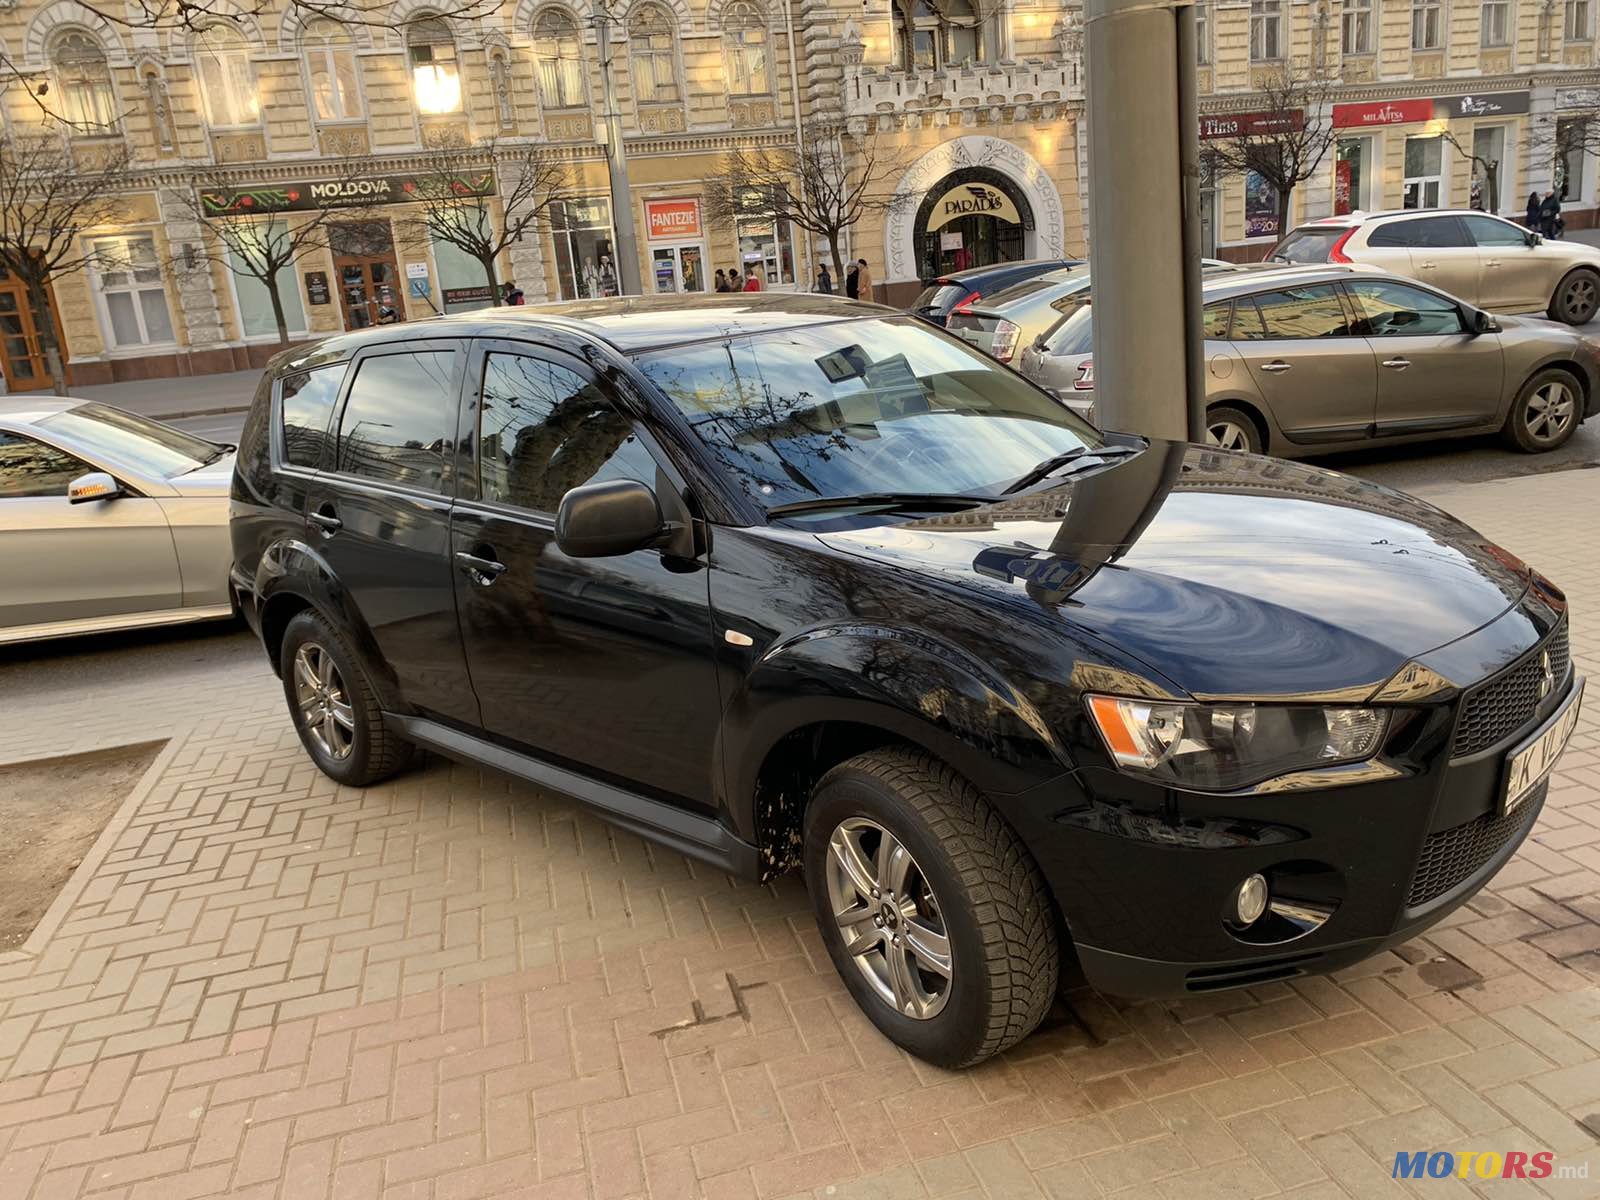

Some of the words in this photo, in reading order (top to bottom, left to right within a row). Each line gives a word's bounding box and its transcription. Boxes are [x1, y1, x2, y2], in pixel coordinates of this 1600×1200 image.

[310, 180, 391, 198] MOLDOVA
[945, 196, 1003, 215] PARADIS
[651, 211, 695, 227] FANTEZIE
